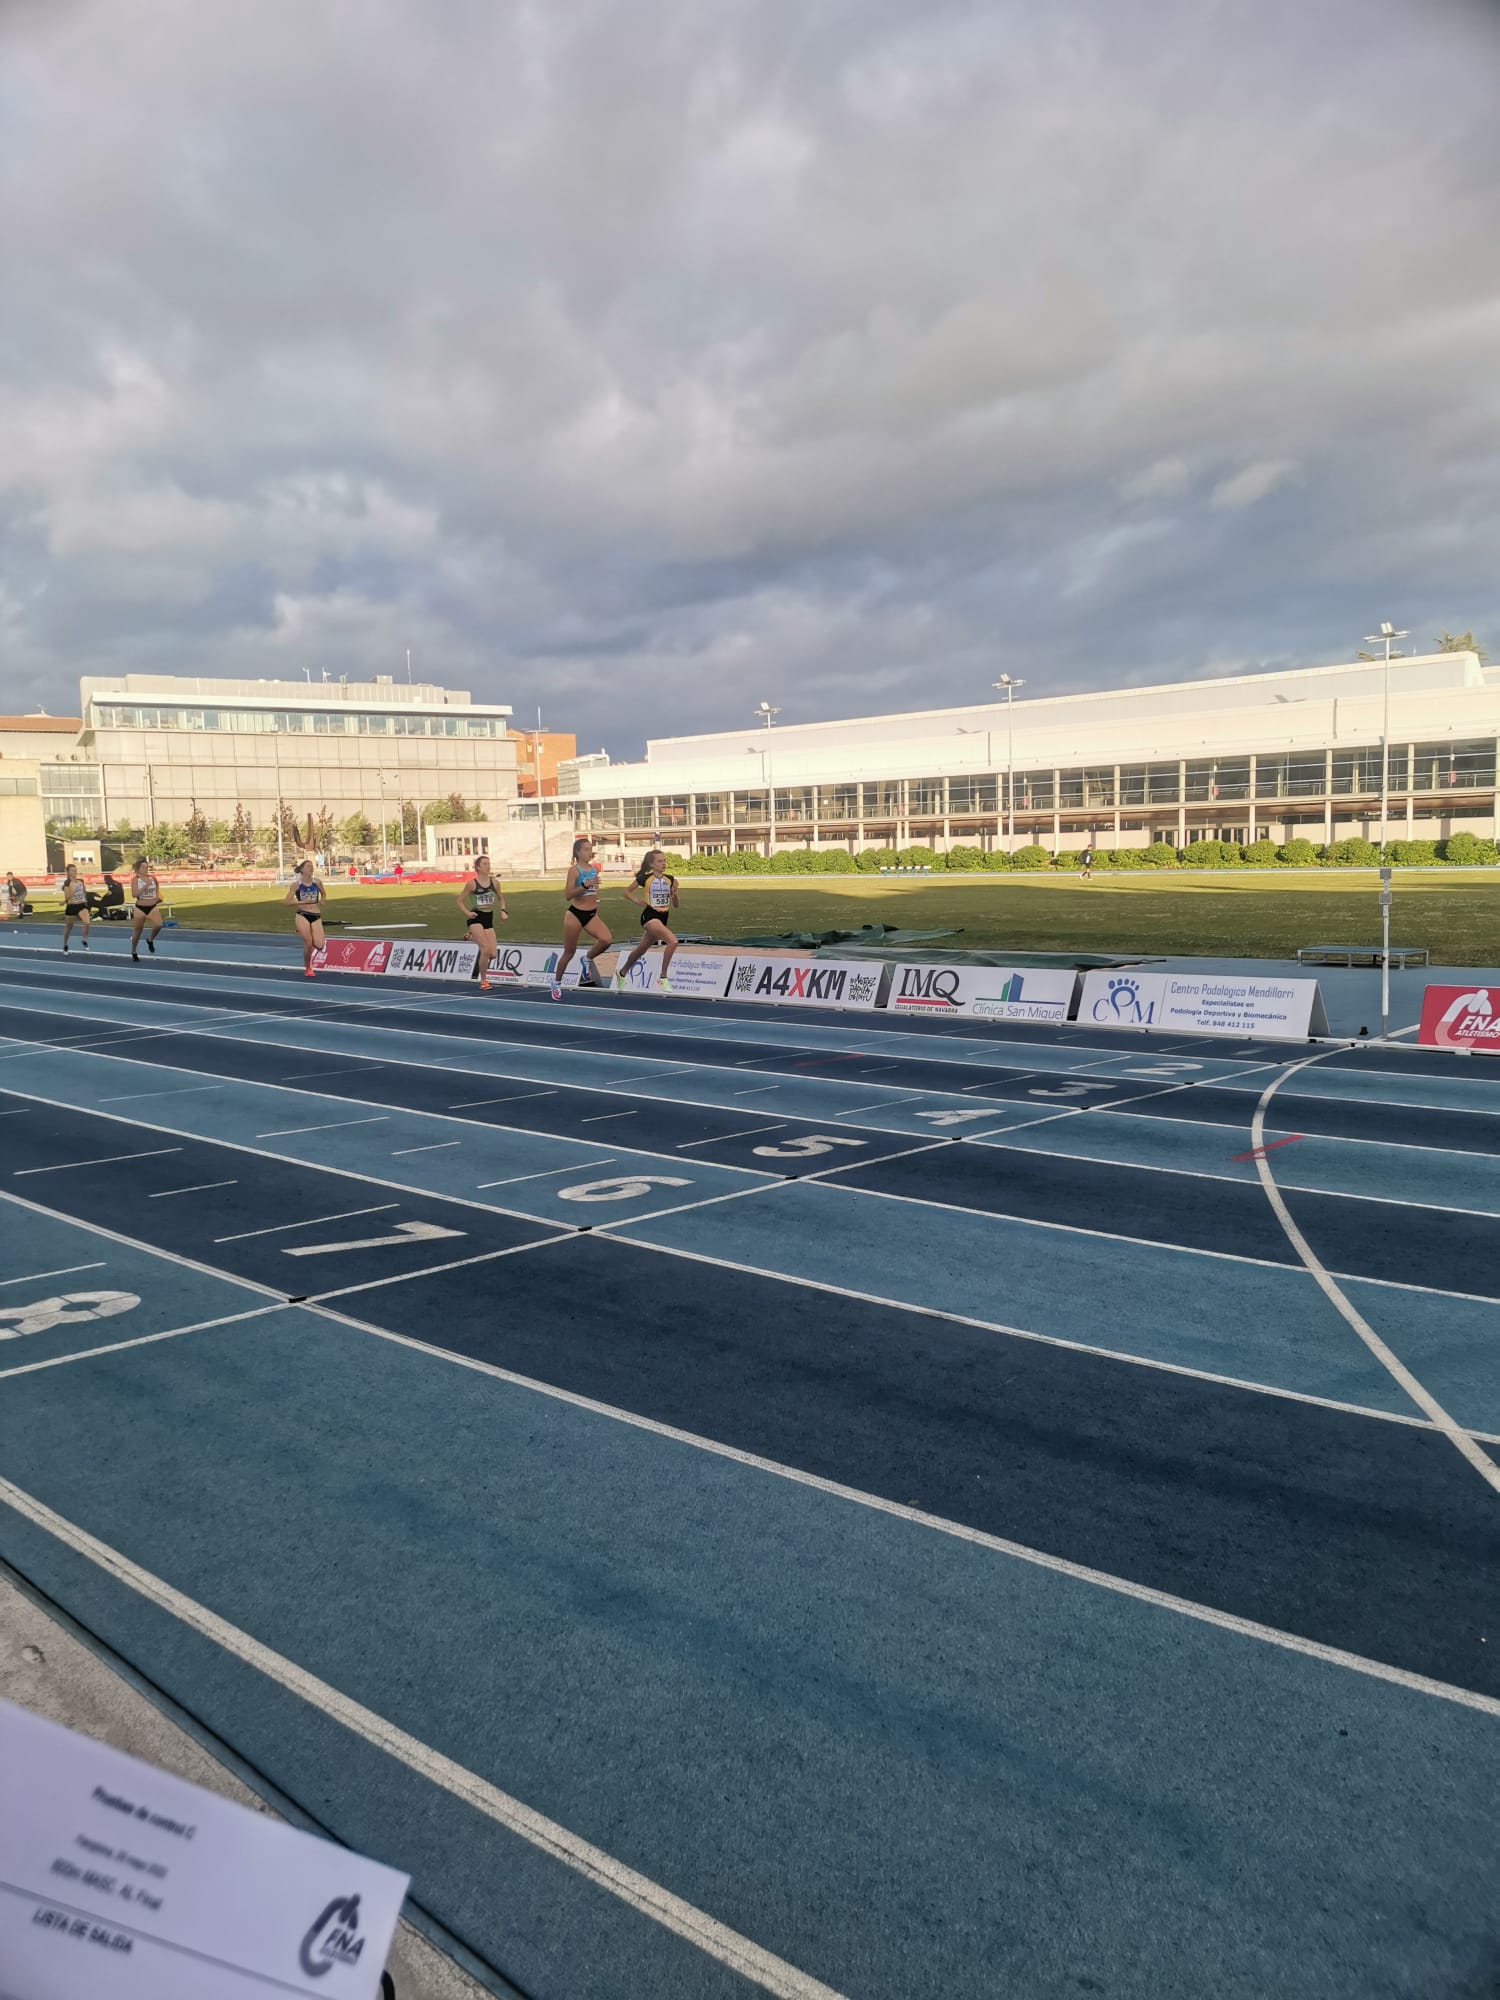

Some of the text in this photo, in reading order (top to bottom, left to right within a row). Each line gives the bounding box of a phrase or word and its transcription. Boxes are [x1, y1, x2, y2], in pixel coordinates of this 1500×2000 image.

[402, 948, 459, 973] A4XKM
[488, 949, 524, 976] MQ
[754, 966, 848, 1000] A4XKM
[898, 968, 965, 1006] IMQ
[1171, 981, 1295, 999] Centro Podológico Mendillorri
[972, 1004, 1004, 1016] Clínica
[1007, 1005, 1025, 1017] San
[1201, 999, 1245, 1008] Especialistas
[1204, 1009, 1236, 1018] Deportiva
[1243, 1011, 1287, 1020] Biomecánica
[1455, 1029, 1500, 1039] ATLETISMO
[1459, 1015, 1500, 1032] FNA
[1121, 1062, 1204, 1076] 2
[1027, 1081, 1118, 1097] 3
[914, 1108, 1007, 1126] 4
[752, 1135, 869, 1157] 5
[557, 1175, 696, 1202] 6
[280, 1220, 468, 1256] 7
[0, 1290, 141, 1341] 8
[69, 1918, 90, 1940] DE
[324, 1927, 366, 1958] FNA
